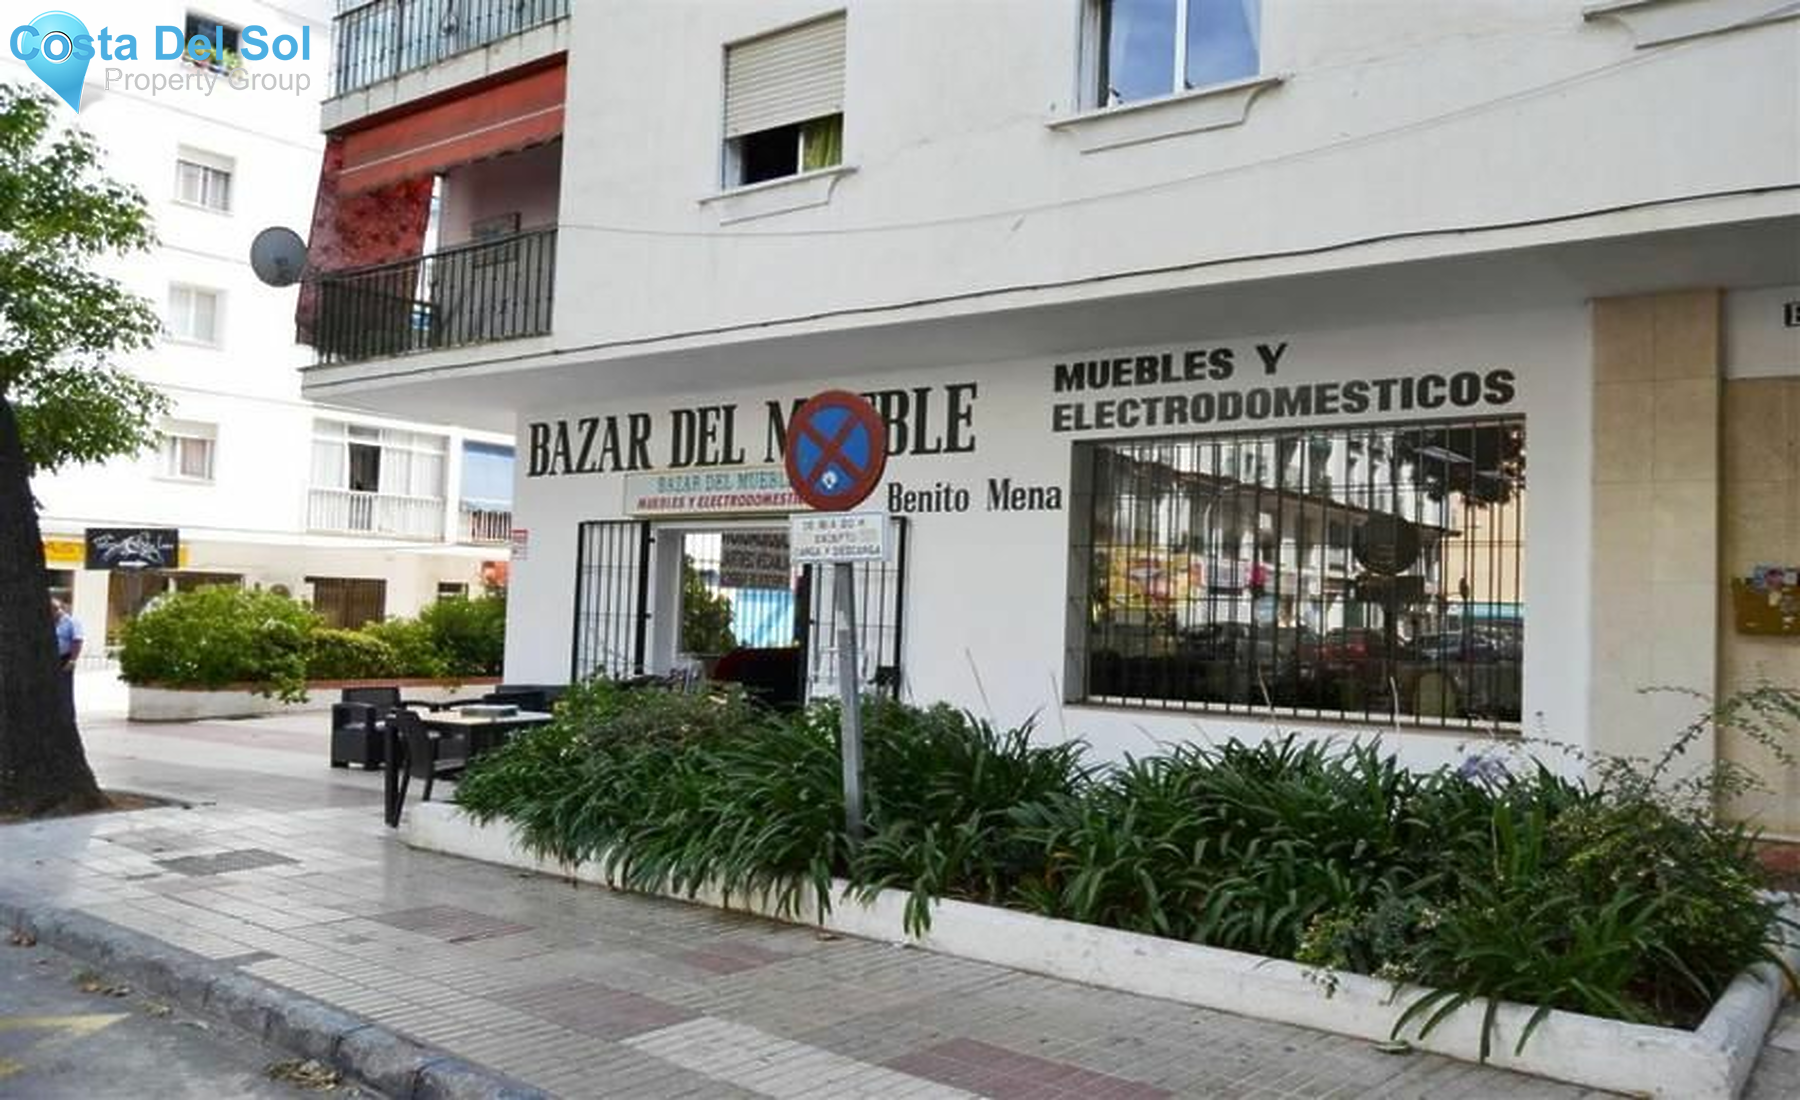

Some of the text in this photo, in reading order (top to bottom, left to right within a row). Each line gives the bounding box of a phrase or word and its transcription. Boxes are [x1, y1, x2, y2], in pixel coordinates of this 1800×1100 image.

[1054, 342, 1287, 392] MUEBLES Y
[1052, 369, 1516, 432] ELECTRODOMESTICOS
[527, 382, 977, 477] BAZAR DEL MBLE
[656, 475, 701, 494] BAZAR
[705, 473, 735, 491] DEL
[888, 478, 1062, 512] Benito Mena
